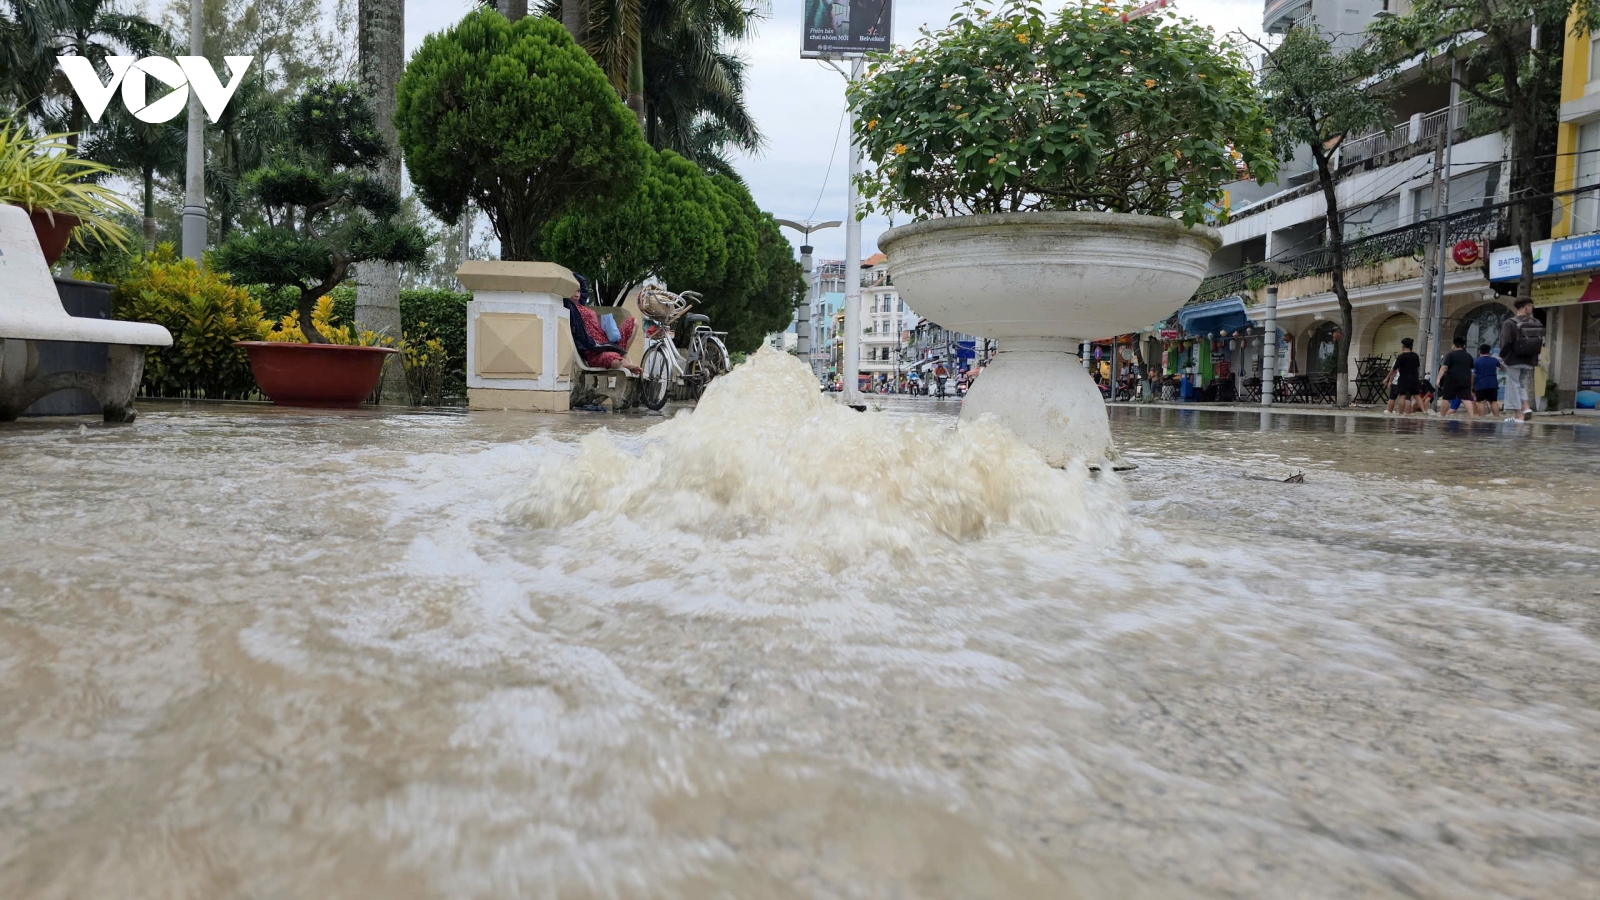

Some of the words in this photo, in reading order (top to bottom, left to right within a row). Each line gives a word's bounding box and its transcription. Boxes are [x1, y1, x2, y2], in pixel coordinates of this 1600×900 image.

[1583, 239, 1595, 249] MỘT
[1561, 252, 1576, 261] MORE
[1576, 249, 1592, 258] THAN
